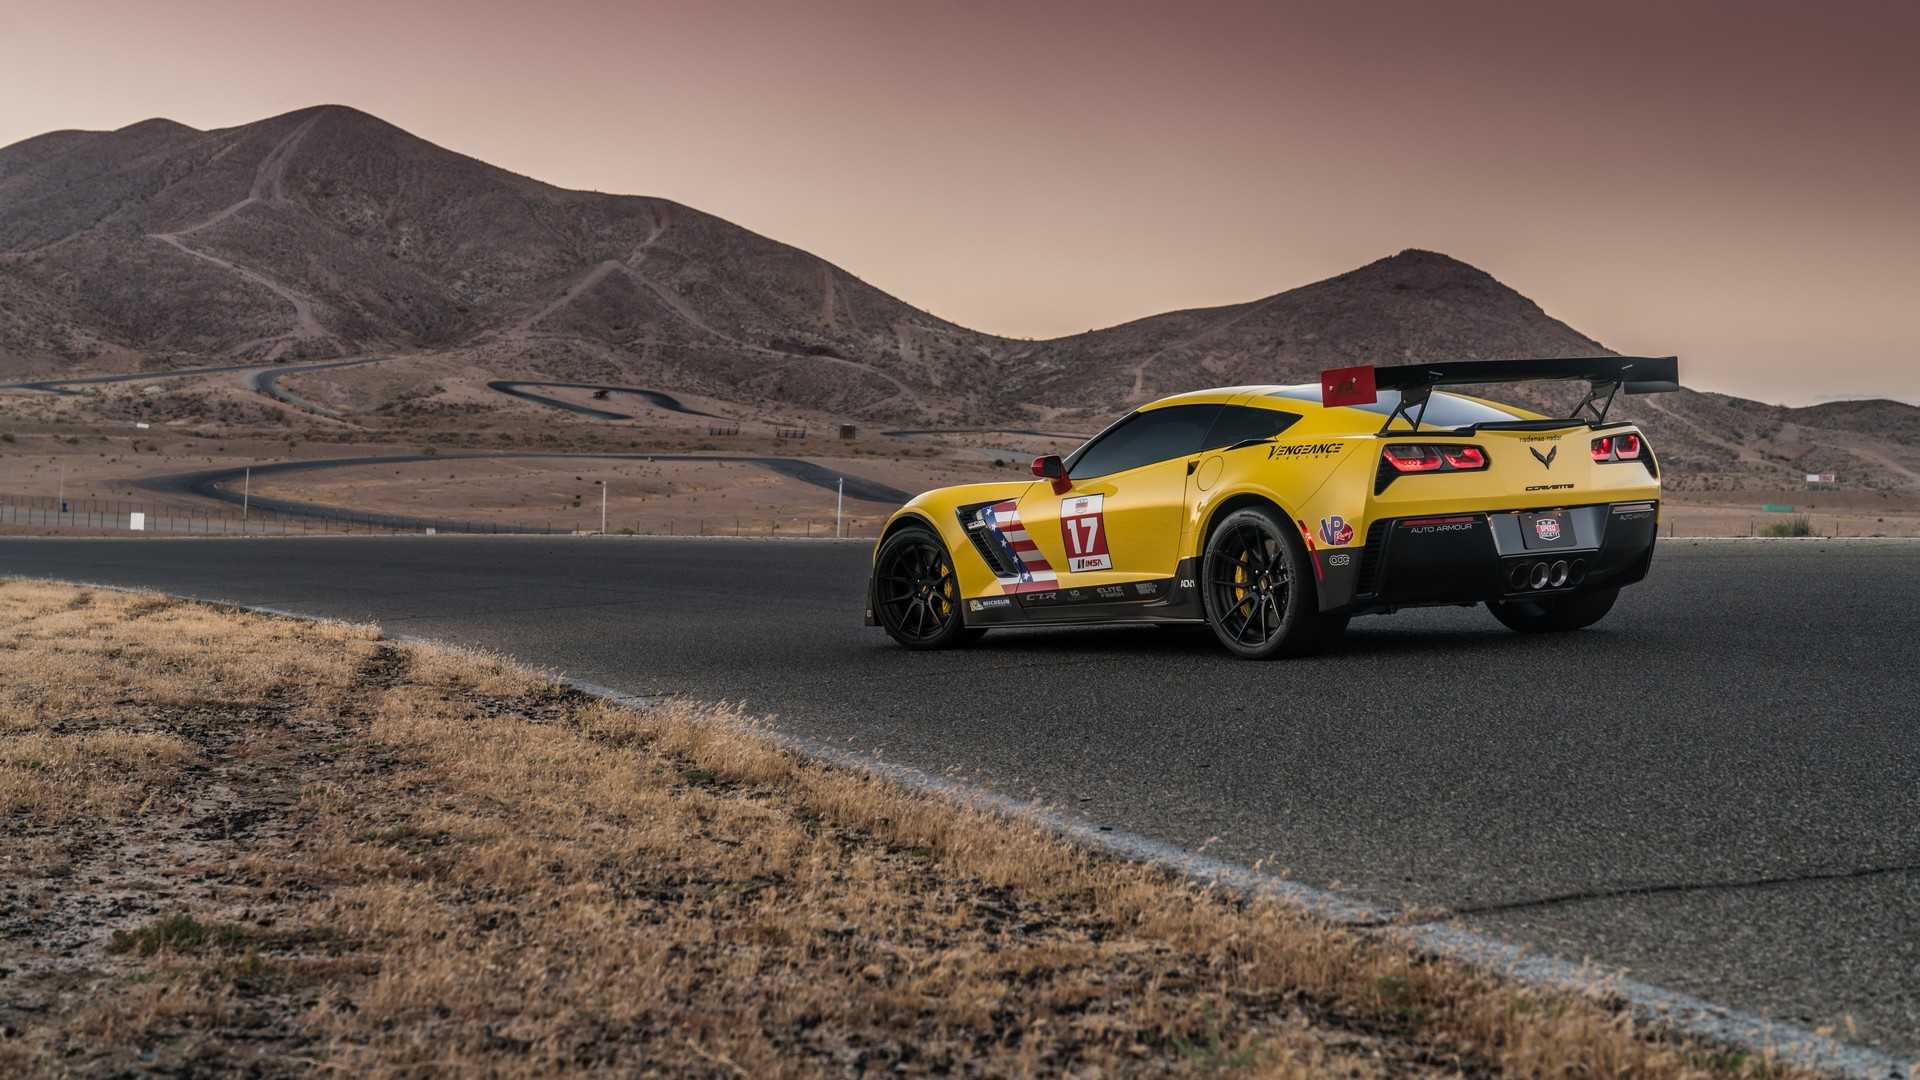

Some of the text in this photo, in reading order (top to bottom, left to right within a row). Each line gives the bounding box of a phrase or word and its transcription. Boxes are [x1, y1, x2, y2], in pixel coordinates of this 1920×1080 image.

[1268, 443, 1344, 460] VENGEANCE
[1525, 483, 1575, 491] CORVETTE
[1437, 523, 1473, 532] ARMOUR
[1067, 517, 1098, 554] 17
